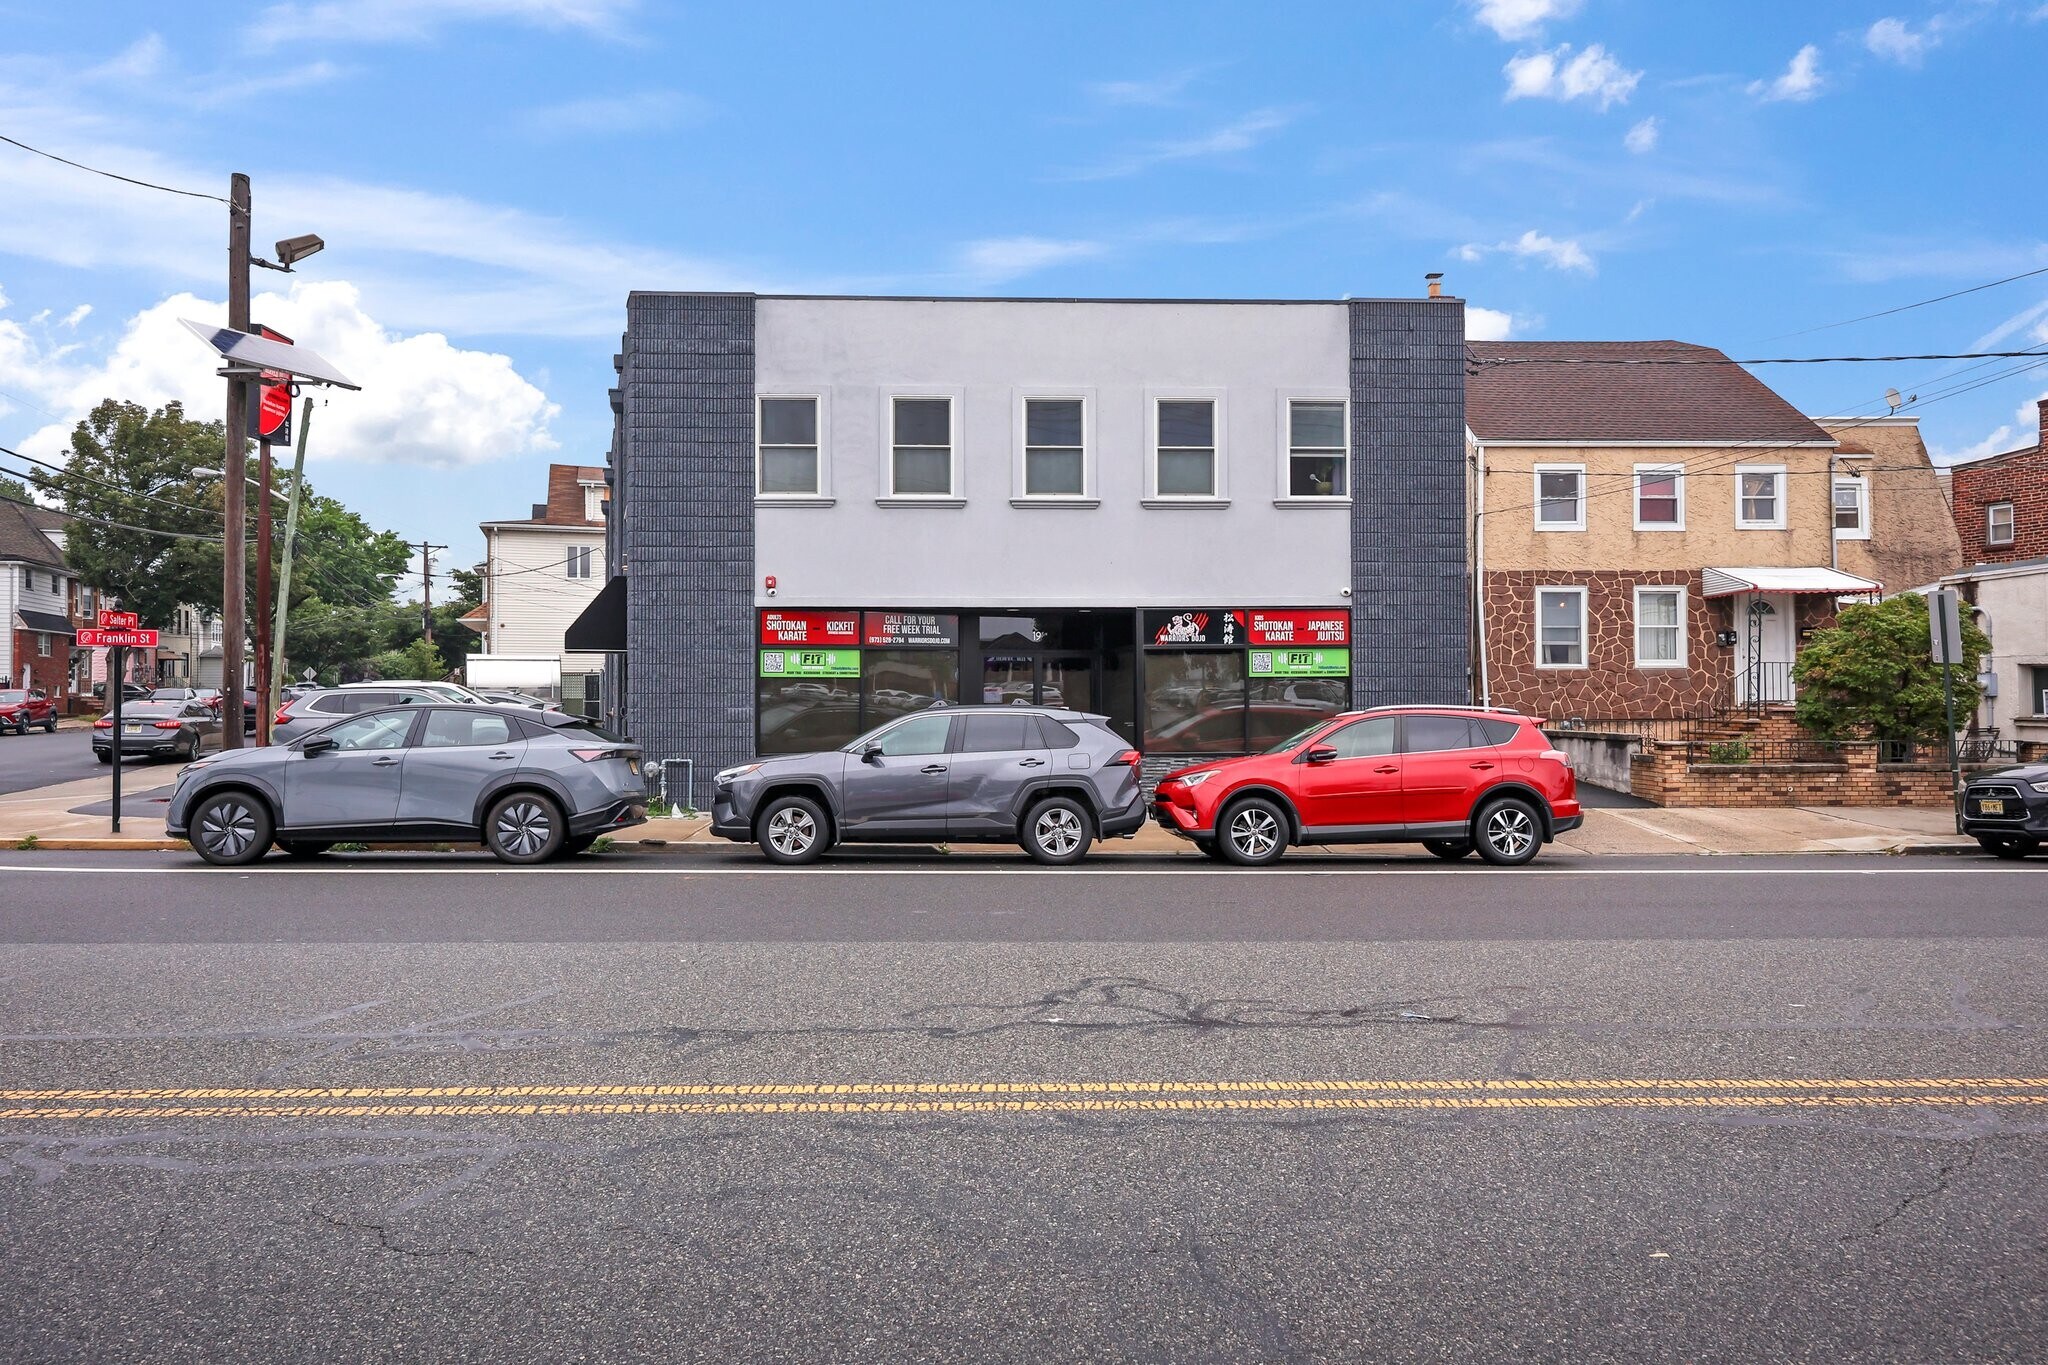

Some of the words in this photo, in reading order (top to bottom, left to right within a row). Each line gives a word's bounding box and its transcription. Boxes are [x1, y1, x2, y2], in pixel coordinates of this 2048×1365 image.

[109, 614, 127, 625] Salter
[128, 616, 134, 626] Pl
[884, 615, 902, 624] CALL
[903, 615, 917, 624] FOR
[918, 616, 936, 625] YOUR
[766, 620, 807, 631] SHOTOKAN
[826, 621, 855, 632] KICKFIT
[882, 624, 900, 634] FREE
[901, 625, 921, 634] WEEK
[922, 626, 941, 634] TRIAL
[1254, 621, 1293, 631] SHOTOKAN
[1308, 621, 1344, 631] JAPANESE
[96, 633, 136, 644] Franklin
[140, 633, 150, 644] St
[778, 630, 808, 641] KARATE
[868, 636, 882, 644] (973)
[1160, 634, 1190, 642] WARRIORS
[1265, 631, 1294, 641] KARATE
[1316, 631, 1344, 641] JUJITSU
